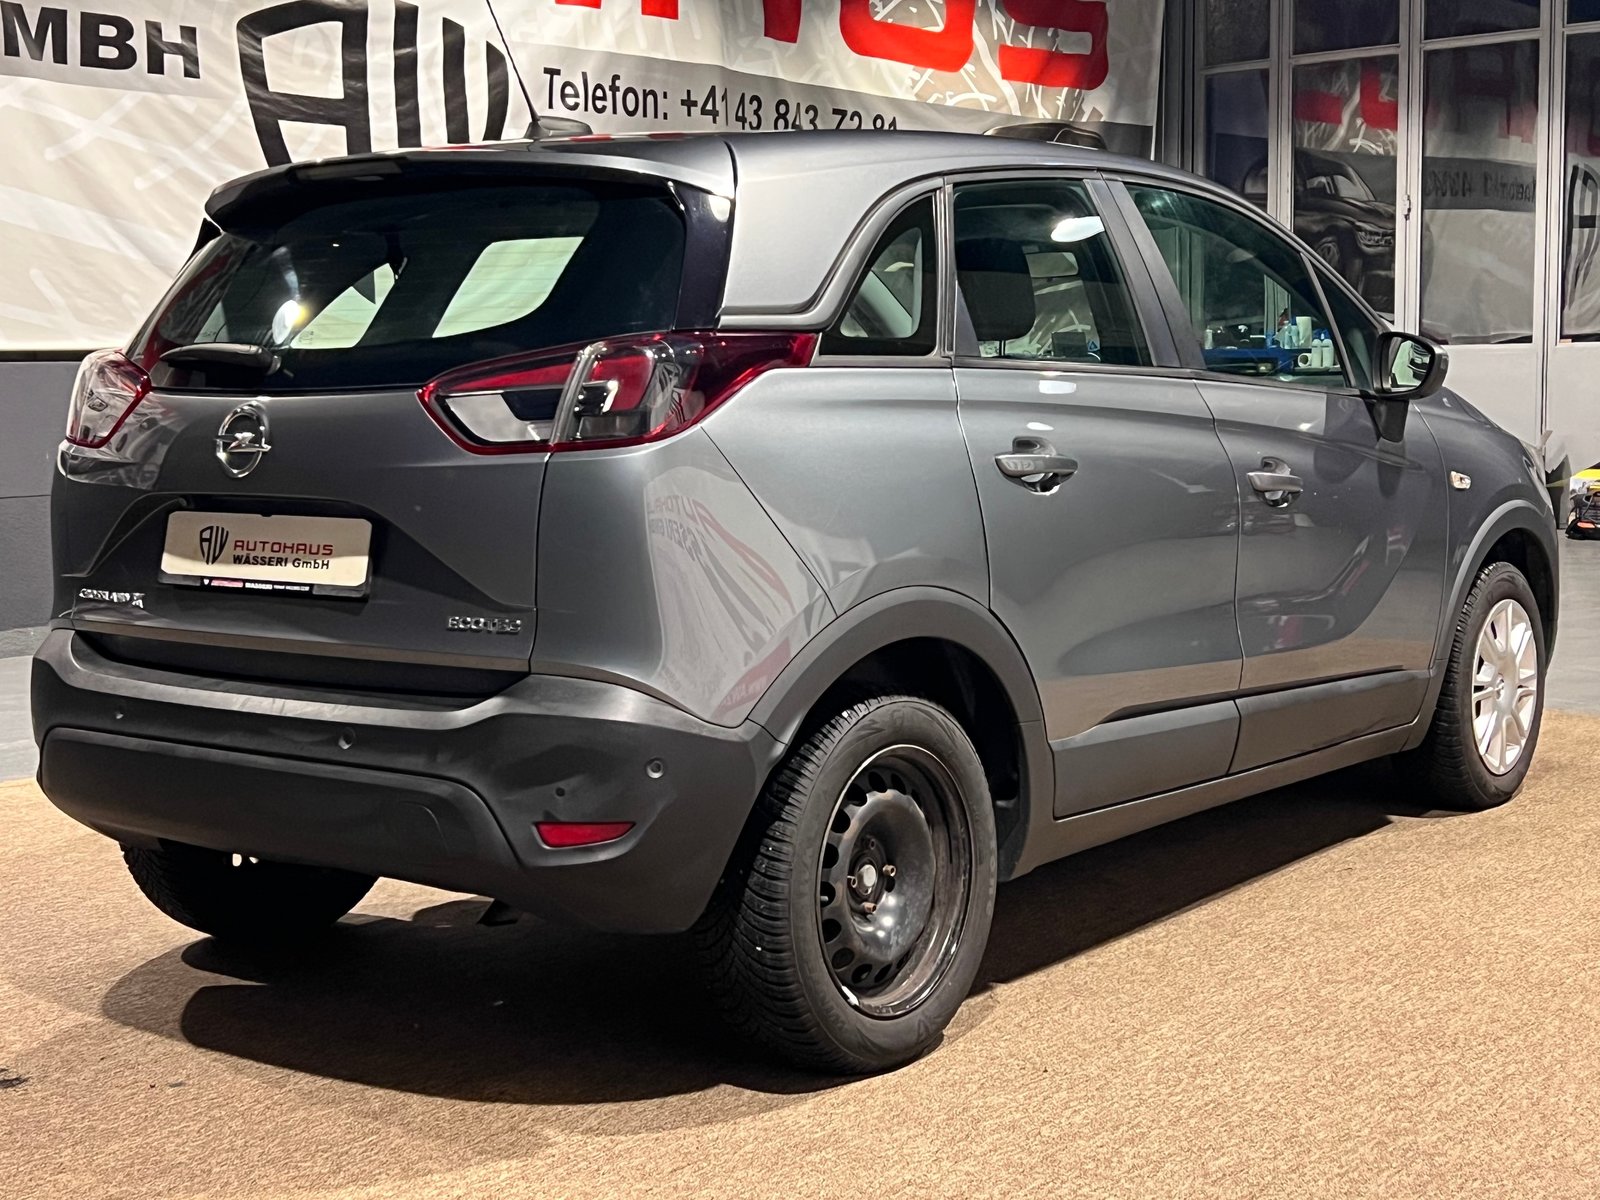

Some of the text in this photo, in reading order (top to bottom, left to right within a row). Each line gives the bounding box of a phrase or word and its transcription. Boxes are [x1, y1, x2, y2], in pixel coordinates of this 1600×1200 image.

[543, 66, 668, 121] Telefon:
[233, 539, 334, 556] AUTOHAUS
[292, 557, 330, 570] GmbH
